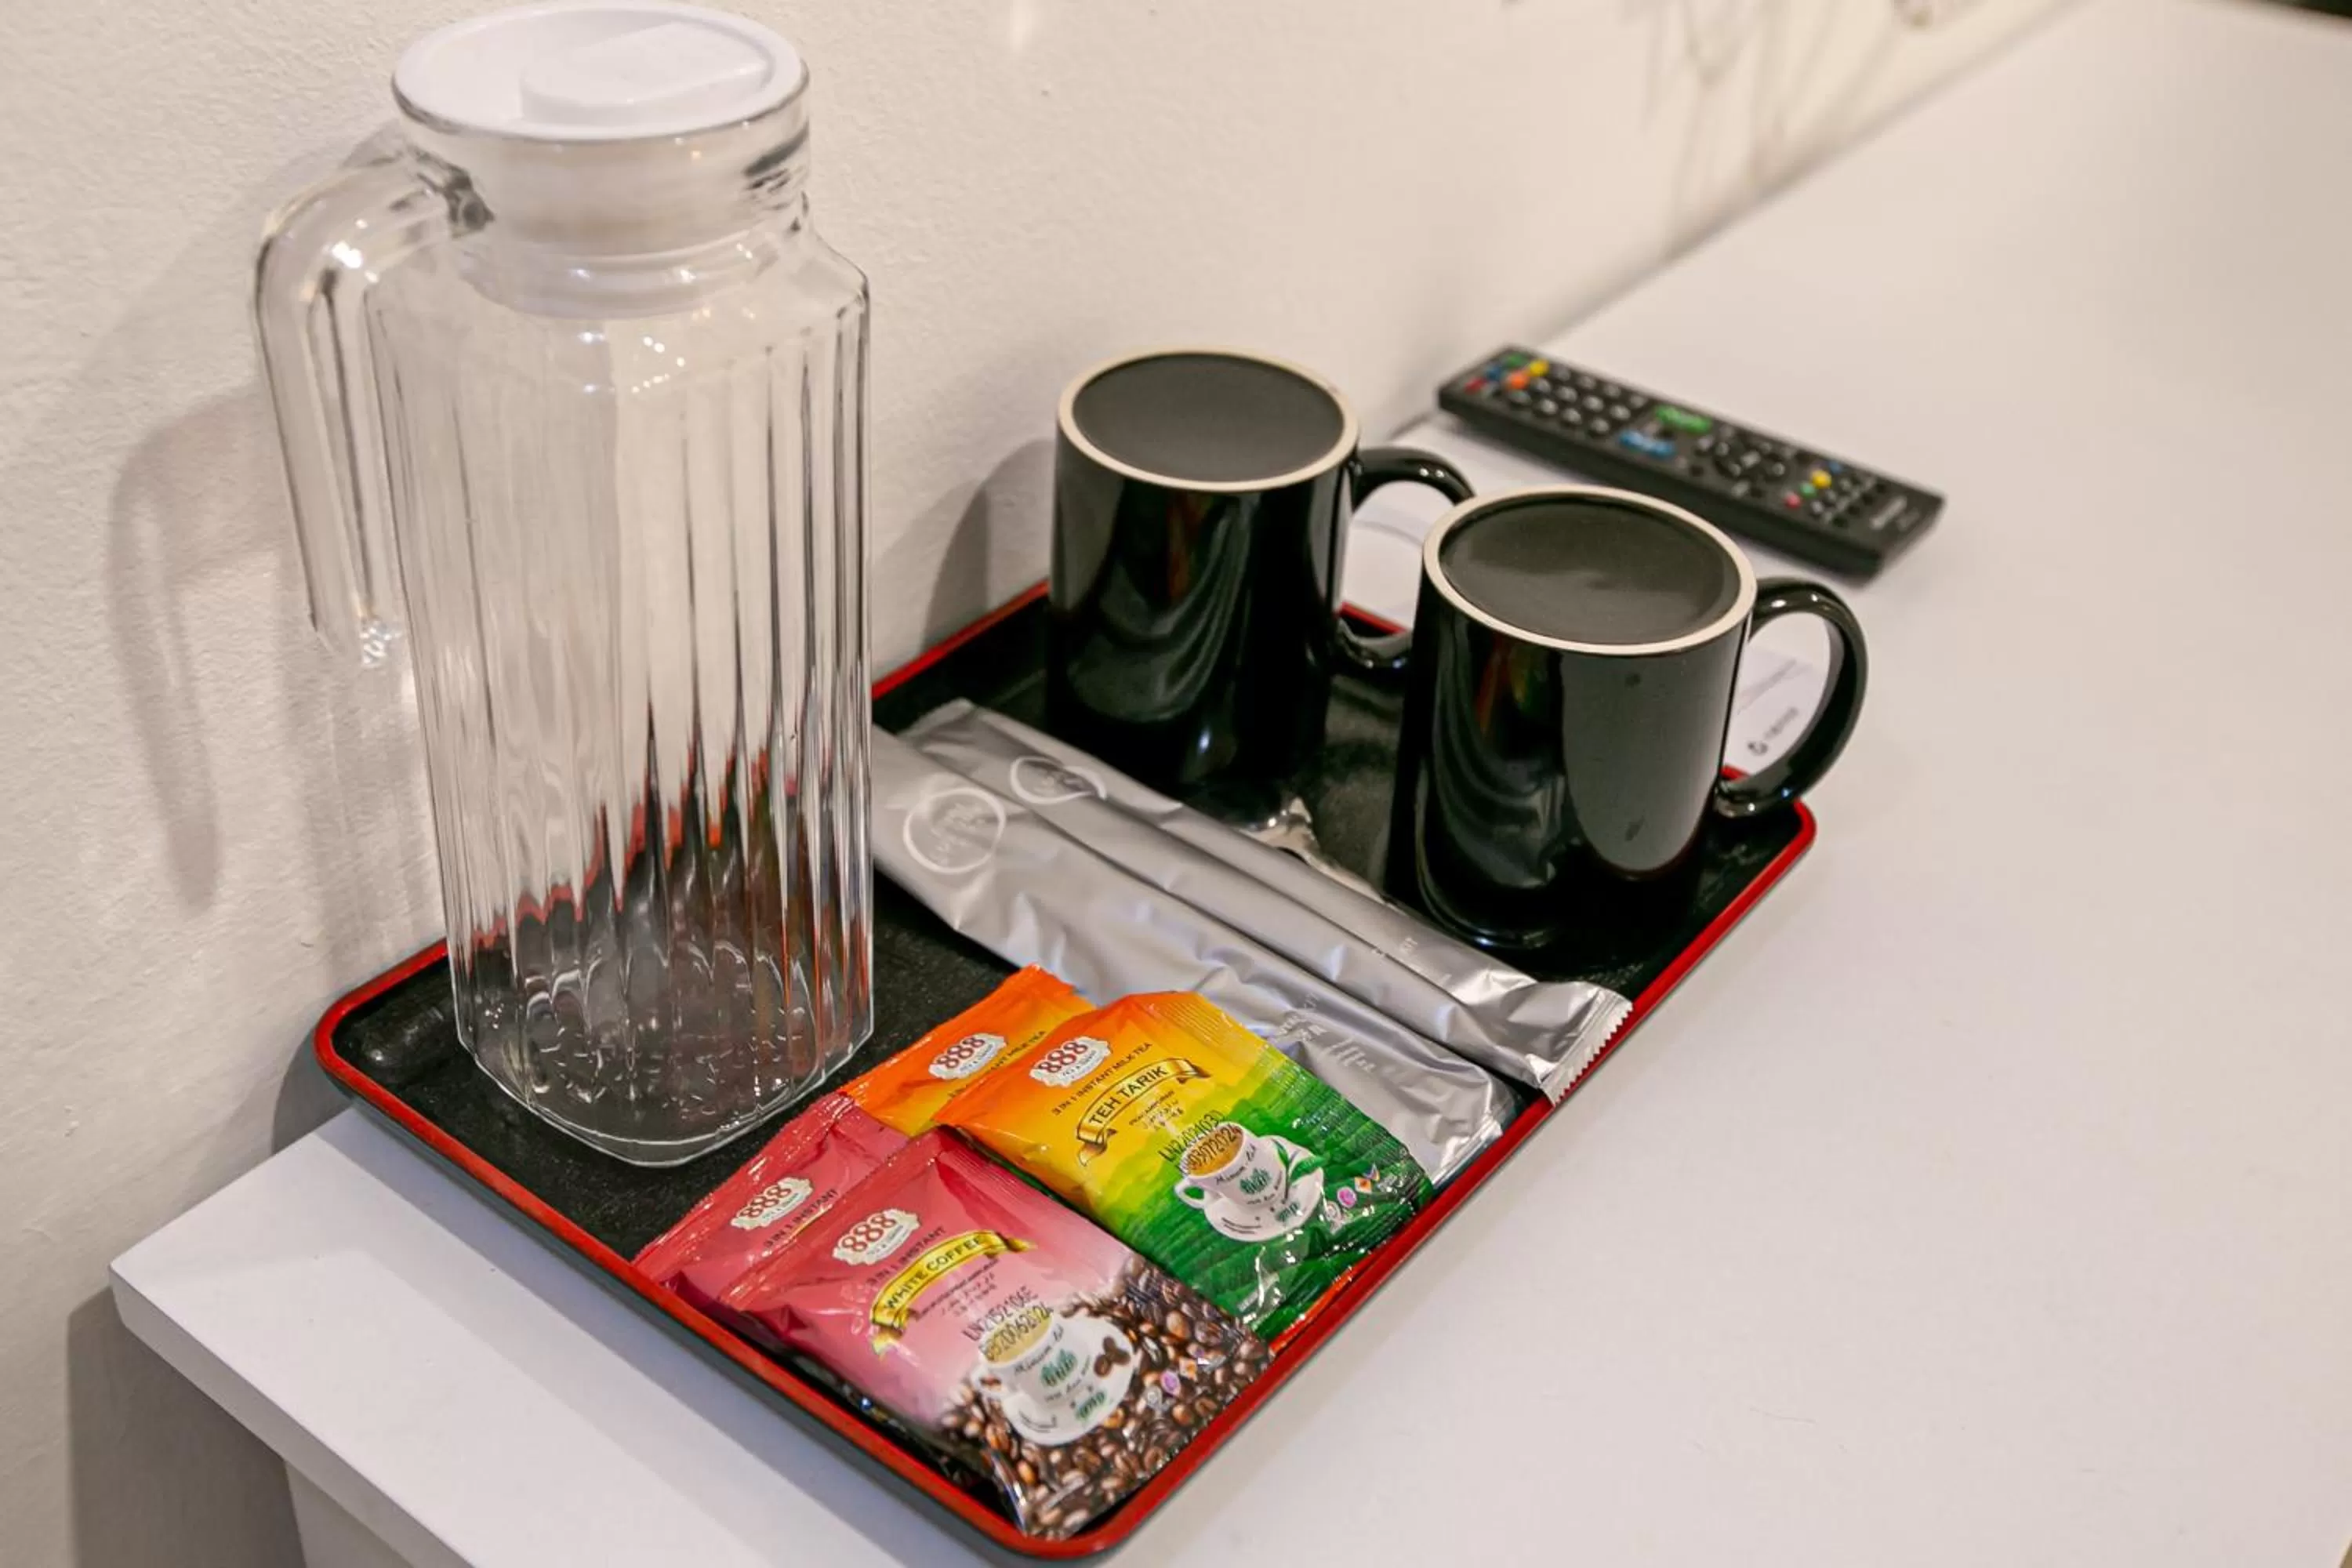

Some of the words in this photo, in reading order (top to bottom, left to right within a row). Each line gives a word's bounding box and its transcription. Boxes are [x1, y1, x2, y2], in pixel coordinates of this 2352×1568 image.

[936, 1036, 985, 1069] 888
[1038, 1041, 1088, 1073] 888
[1076, 1068, 1114, 1098] INSTANT
[1112, 1052, 1135, 1069] MILK
[1133, 1042, 1152, 1056] TEA
[1088, 1096, 1122, 1124] TEH
[1116, 1065, 1169, 1098] TARIK
[739, 1185, 792, 1218] 888
[792, 1189, 839, 1223] INSTANT
[841, 1215, 897, 1252] 888
[898, 1225, 946, 1265] INSTANT
[885, 1269, 929, 1308] WHITE
[926, 1234, 982, 1272] COFFEE
